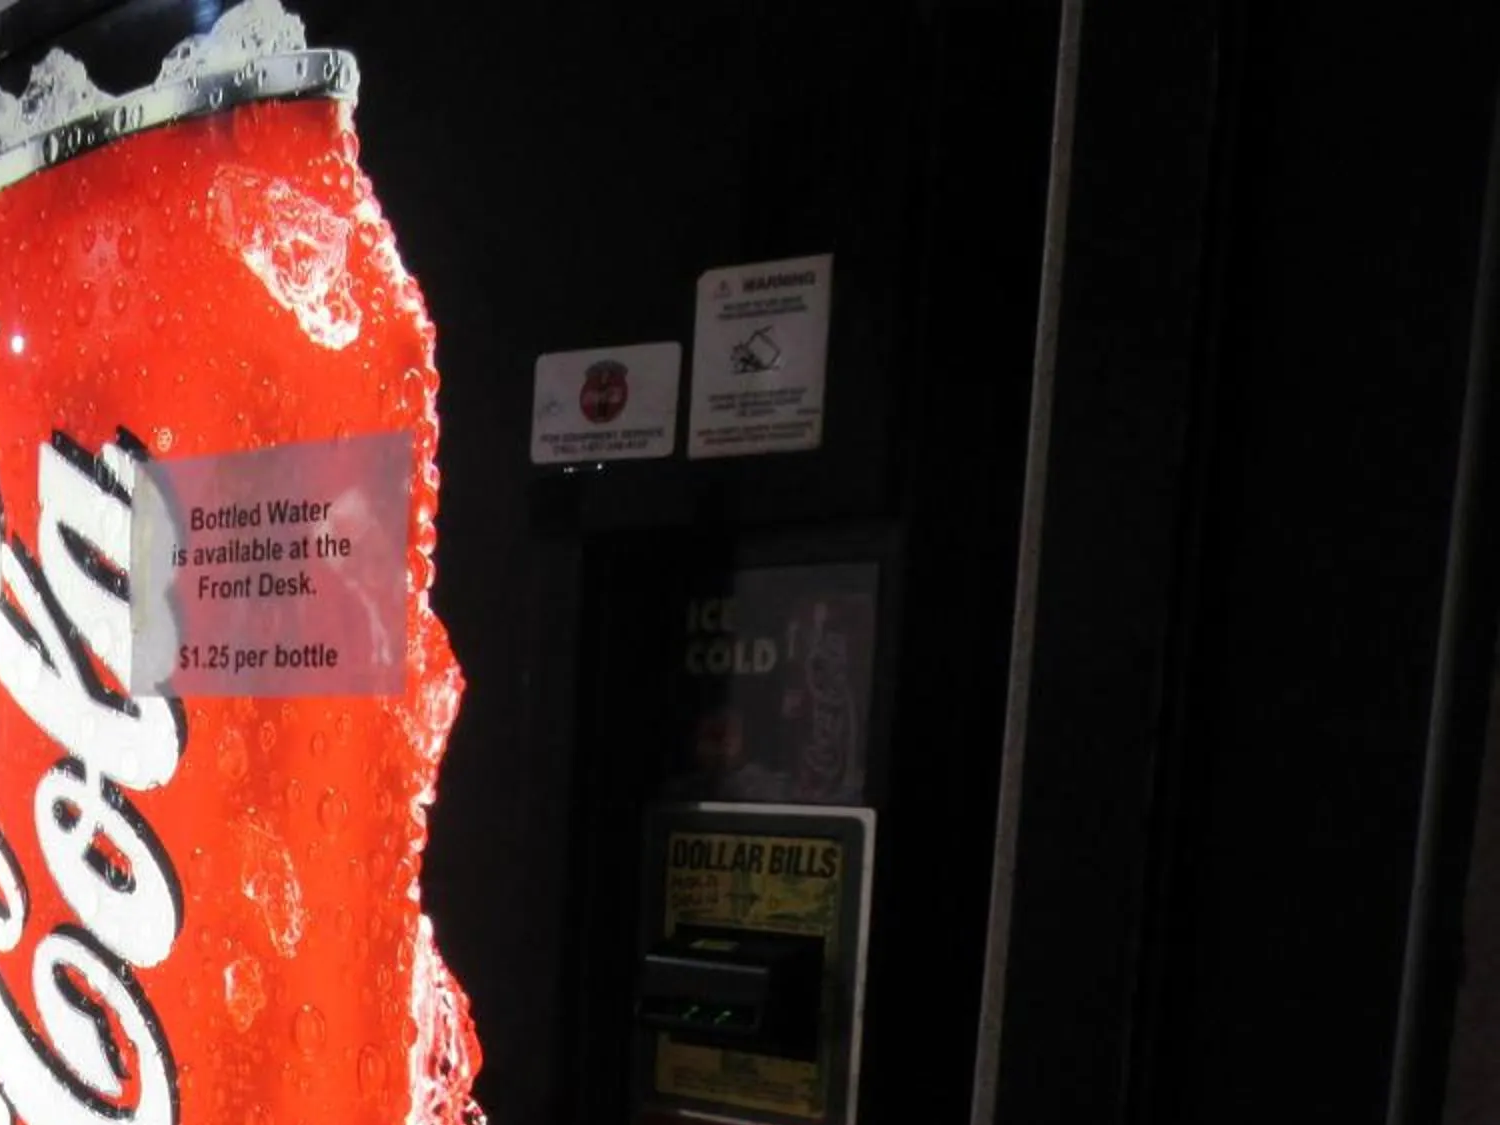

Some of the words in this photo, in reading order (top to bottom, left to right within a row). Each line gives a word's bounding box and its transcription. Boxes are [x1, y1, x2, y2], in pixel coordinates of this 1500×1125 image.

[191, 504, 261, 531] Bottled
[267, 499, 331, 525] Water
[172, 543, 187, 567] is
[193, 539, 283, 566] available
[289, 535, 309, 560] at
[316, 532, 351, 558] the
[198, 573, 251, 600] Front
[258, 570, 317, 598] Desk.
[179, 643, 230, 670] $1.25
[234, 647, 267, 673] per
[274, 643, 338, 668] bottle
[684, 636, 778, 676] COLD
[672, 838, 766, 874] DOLLAR
[768, 844, 839, 879] BILLS
